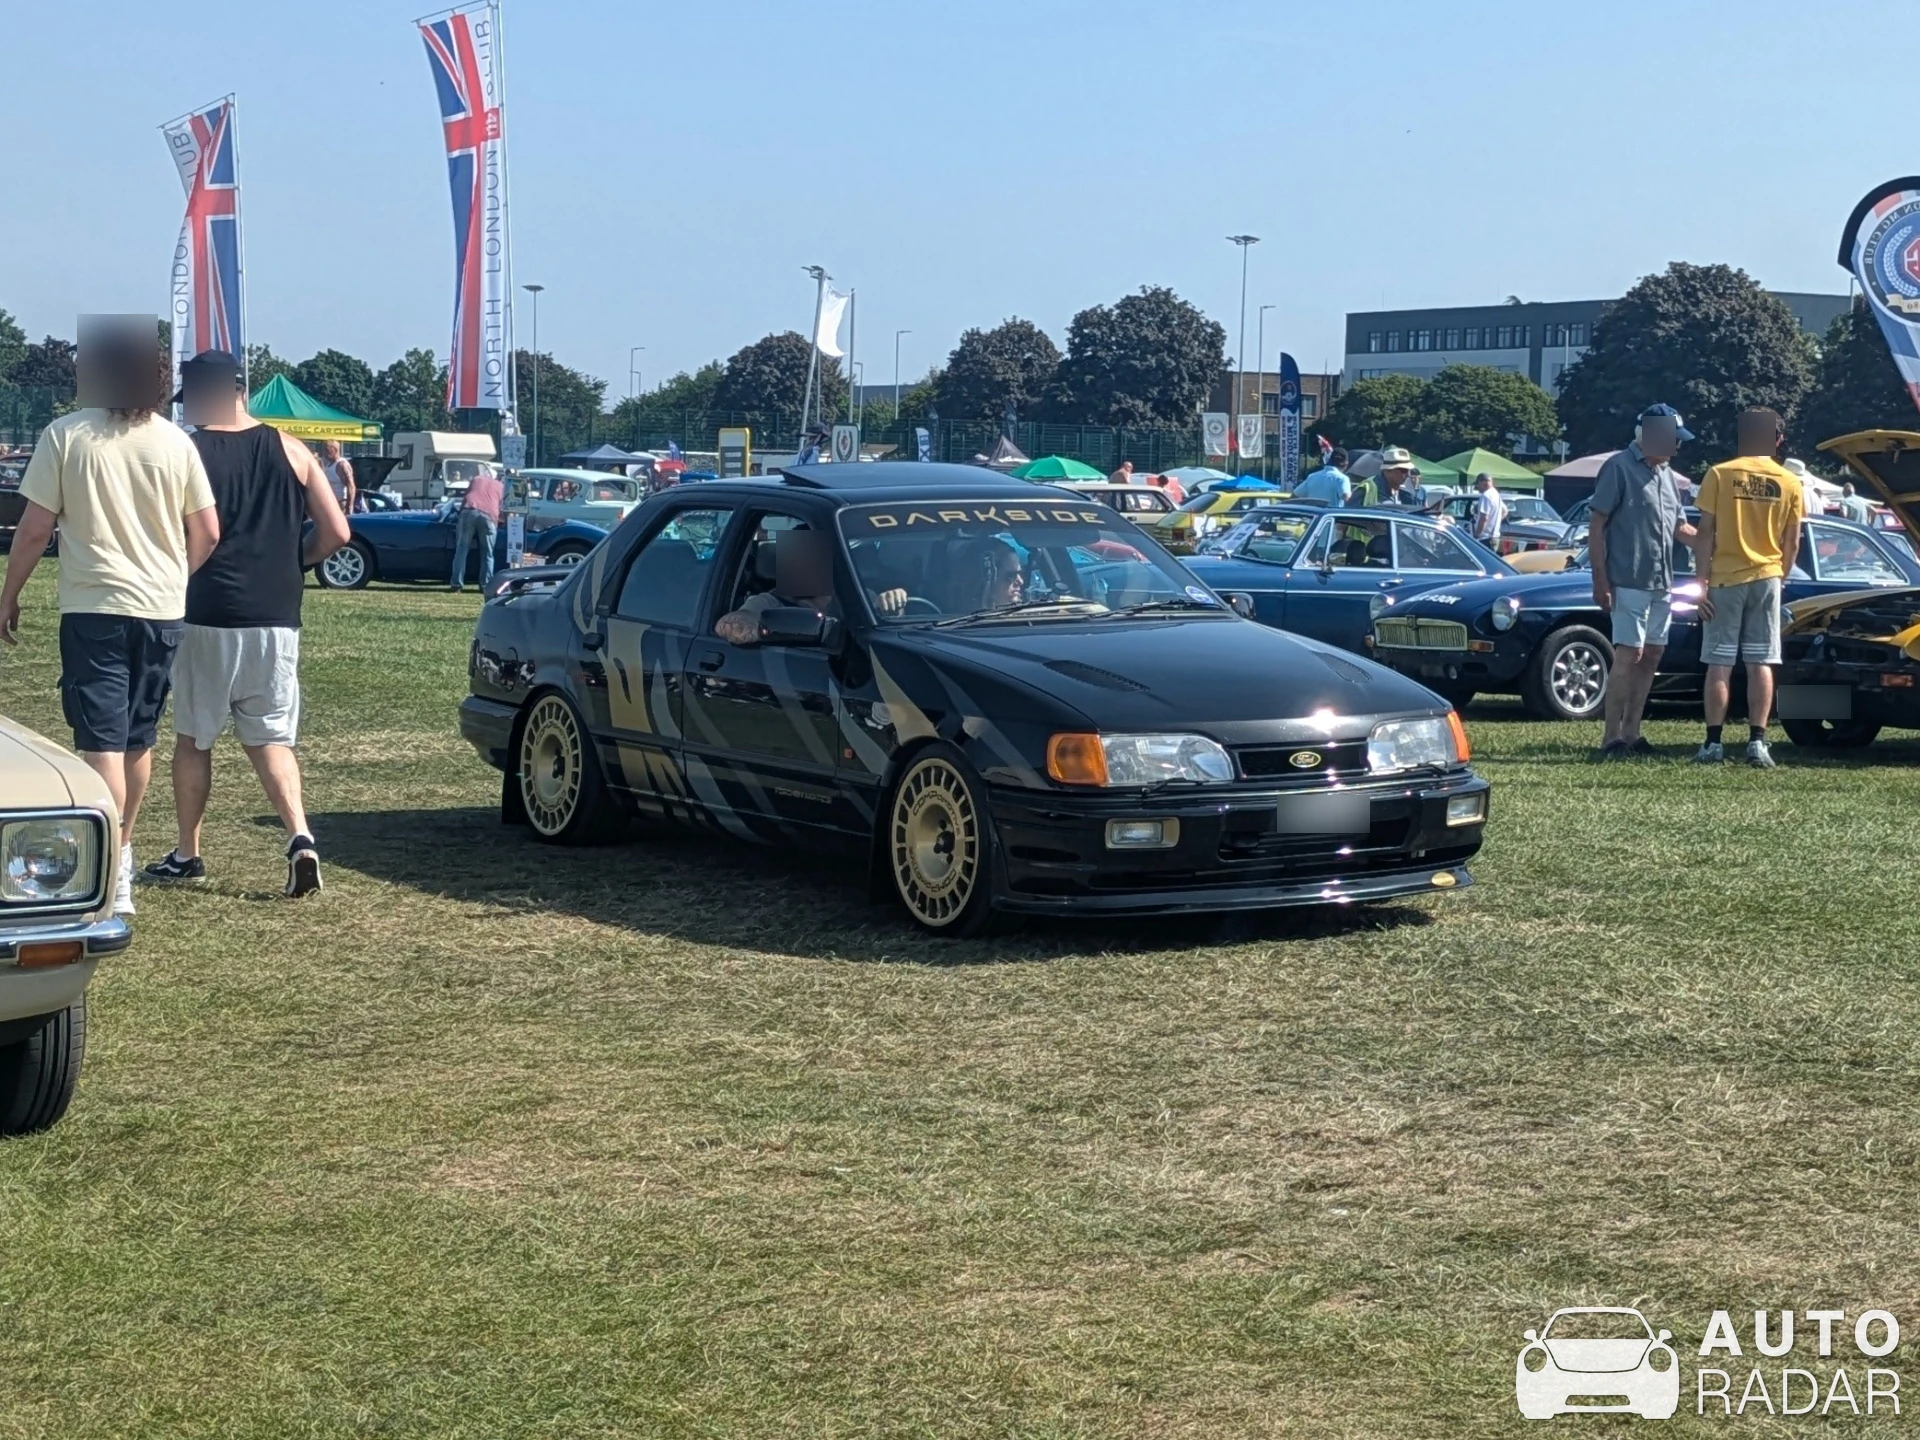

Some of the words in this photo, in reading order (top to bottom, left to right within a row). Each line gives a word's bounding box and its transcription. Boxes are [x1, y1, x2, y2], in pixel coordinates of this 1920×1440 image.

[485, 299, 502, 398] NORTH
[314, 426, 332, 434] CAR
[868, 505, 1106, 528] DARKSIDE
